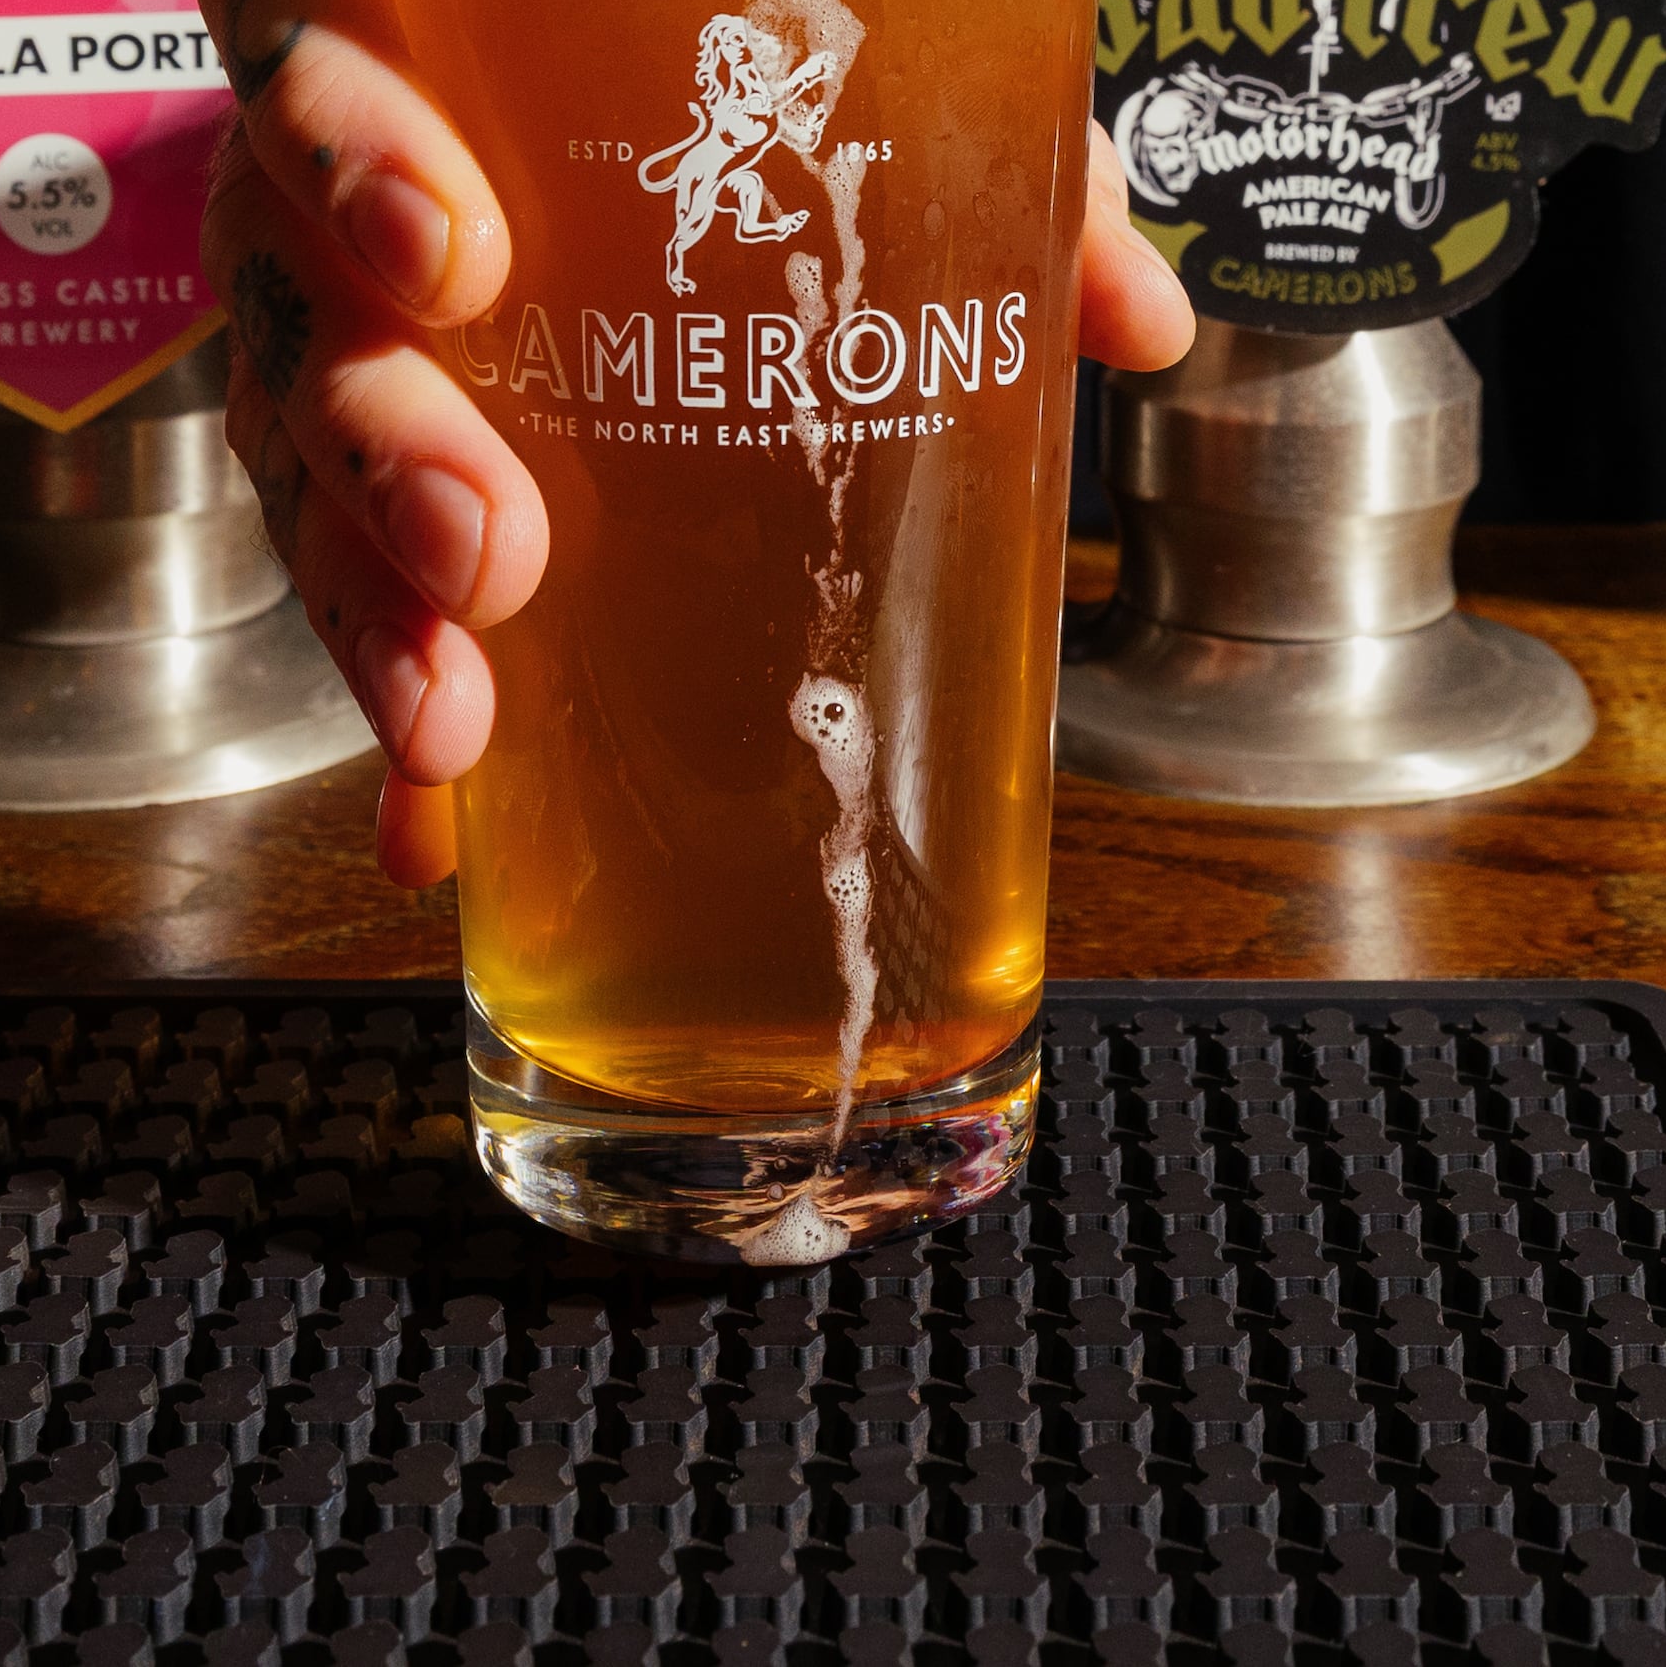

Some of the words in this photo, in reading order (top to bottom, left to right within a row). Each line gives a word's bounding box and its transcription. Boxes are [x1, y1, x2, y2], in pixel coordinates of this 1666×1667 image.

[31, 153, 69, 171] ALC
[568, 141, 635, 163] ESTD
[836, 140, 893, 162] 1865
[7, 178, 96, 210] 5.5%
[1243, 174, 1393, 214] AMERICAN
[33, 219, 71, 238] VOL
[1259, 203, 1321, 230] PALE
[1322, 204, 1370, 234] ALE
[1265, 243, 1335, 263] BREWED
[1337, 245, 1361, 264] BY
[56, 275, 194, 307] CASTLE
[1209, 258, 1418, 305] CAMERONS
[455, 291, 1026, 410] CAMERONS
[530, 413, 578, 437] THE
[595, 420, 699, 446] NORTH
[717, 424, 791, 447] EAST
[813, 412, 944, 446] BREWERS
